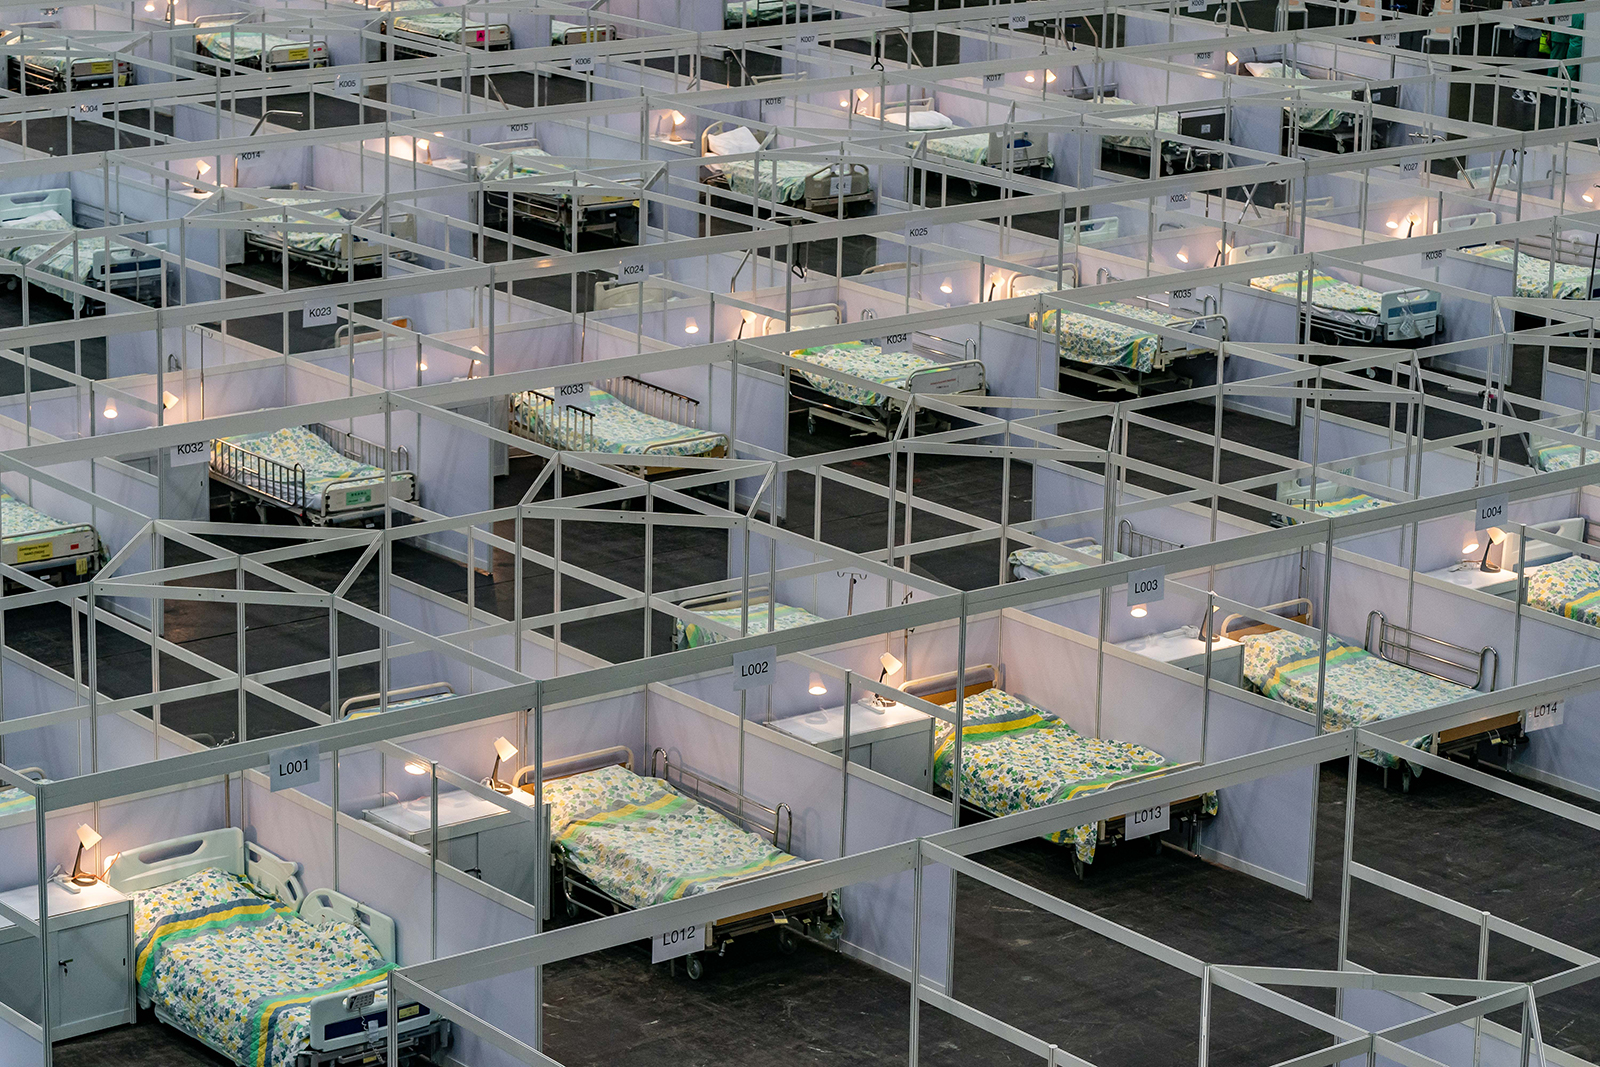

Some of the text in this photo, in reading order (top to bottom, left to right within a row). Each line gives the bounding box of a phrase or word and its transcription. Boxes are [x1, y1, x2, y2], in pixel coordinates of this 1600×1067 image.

[339, 80, 356, 88] K005
[80, 105, 98, 113] K004
[242, 152, 260, 160] K014
[1403, 163, 1418, 171] K027
[910, 228, 928, 236] K025
[624, 265, 644, 275] K024
[1173, 290, 1191, 299] K035
[309, 307, 331, 317] K023
[886, 333, 907, 344] K034
[560, 384, 583, 396] K033
[178, 442, 203, 455] K032
[1482, 505, 1502, 519] L004
[1135, 579, 1158, 594] L003
[742, 662, 768, 677] L002
[1534, 702, 1557, 718] L014
[280, 759, 308, 776] L001
[1135, 806, 1161, 824] L013
[663, 926, 695, 946] L012
